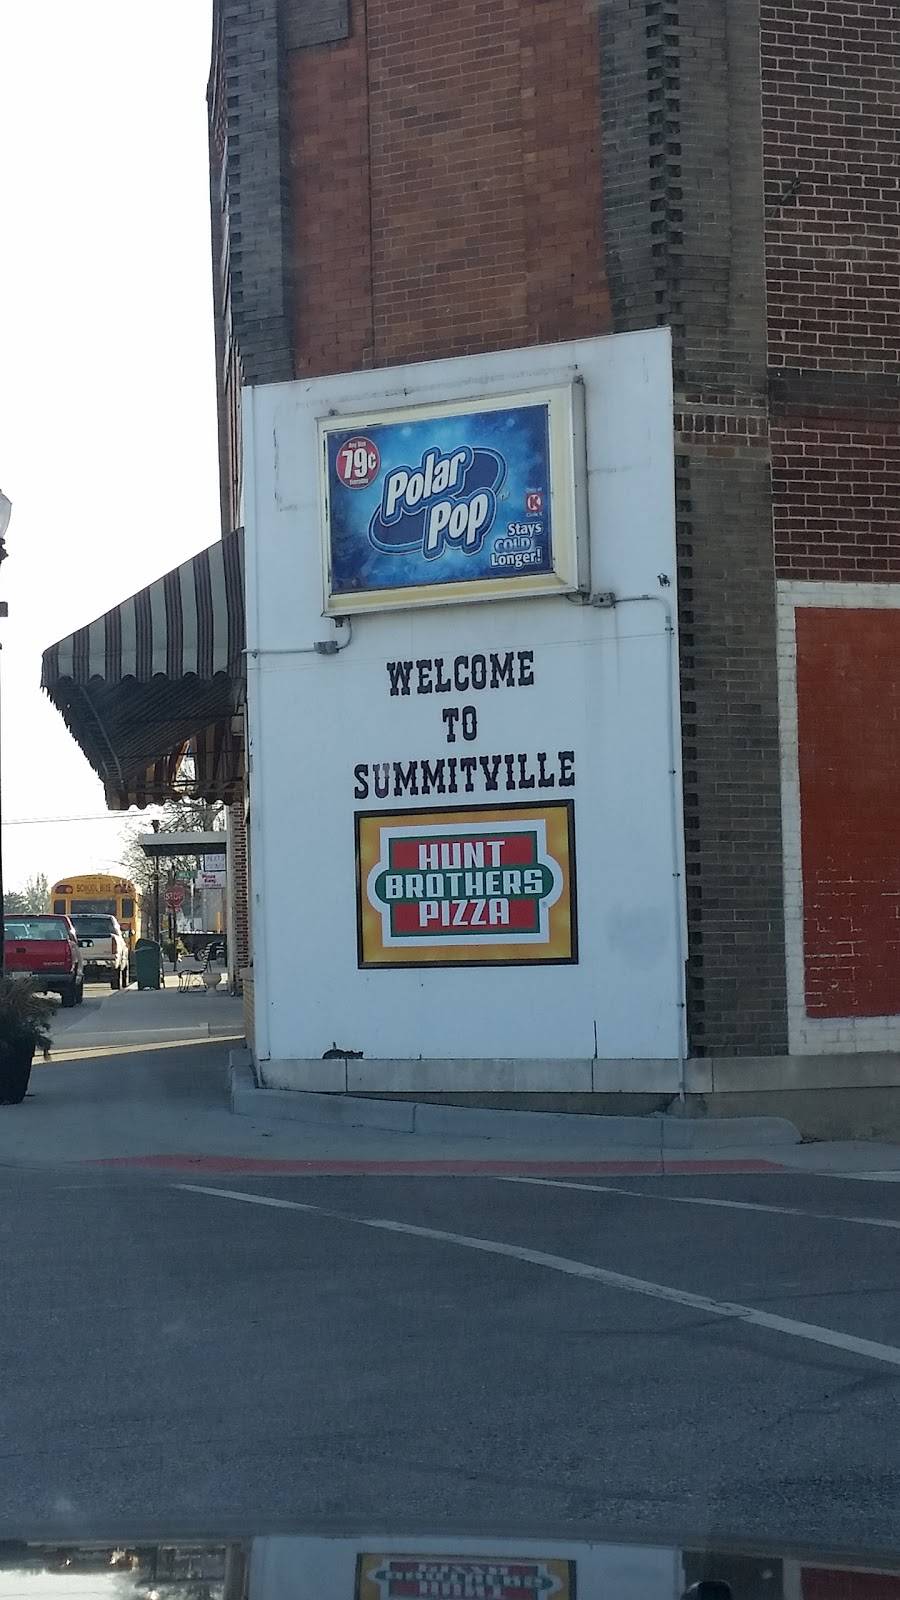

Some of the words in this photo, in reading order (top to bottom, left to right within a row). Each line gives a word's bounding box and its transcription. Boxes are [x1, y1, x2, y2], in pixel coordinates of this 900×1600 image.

[342, 448, 377, 479] 79¢
[385, 450, 467, 518] Polar
[427, 494, 489, 550] Pop
[508, 523, 542, 537] Stays
[491, 549, 542, 568] Longer!
[495, 537, 531, 553] COLD
[387, 650, 534, 696] WELCOME
[442, 706, 478, 742] TO
[354, 751, 575, 800] SUMMITVILLE
[418, 841, 505, 870] HUNT
[386, 869, 543, 899] BROTHERS
[419, 898, 510, 927] PIZZA
